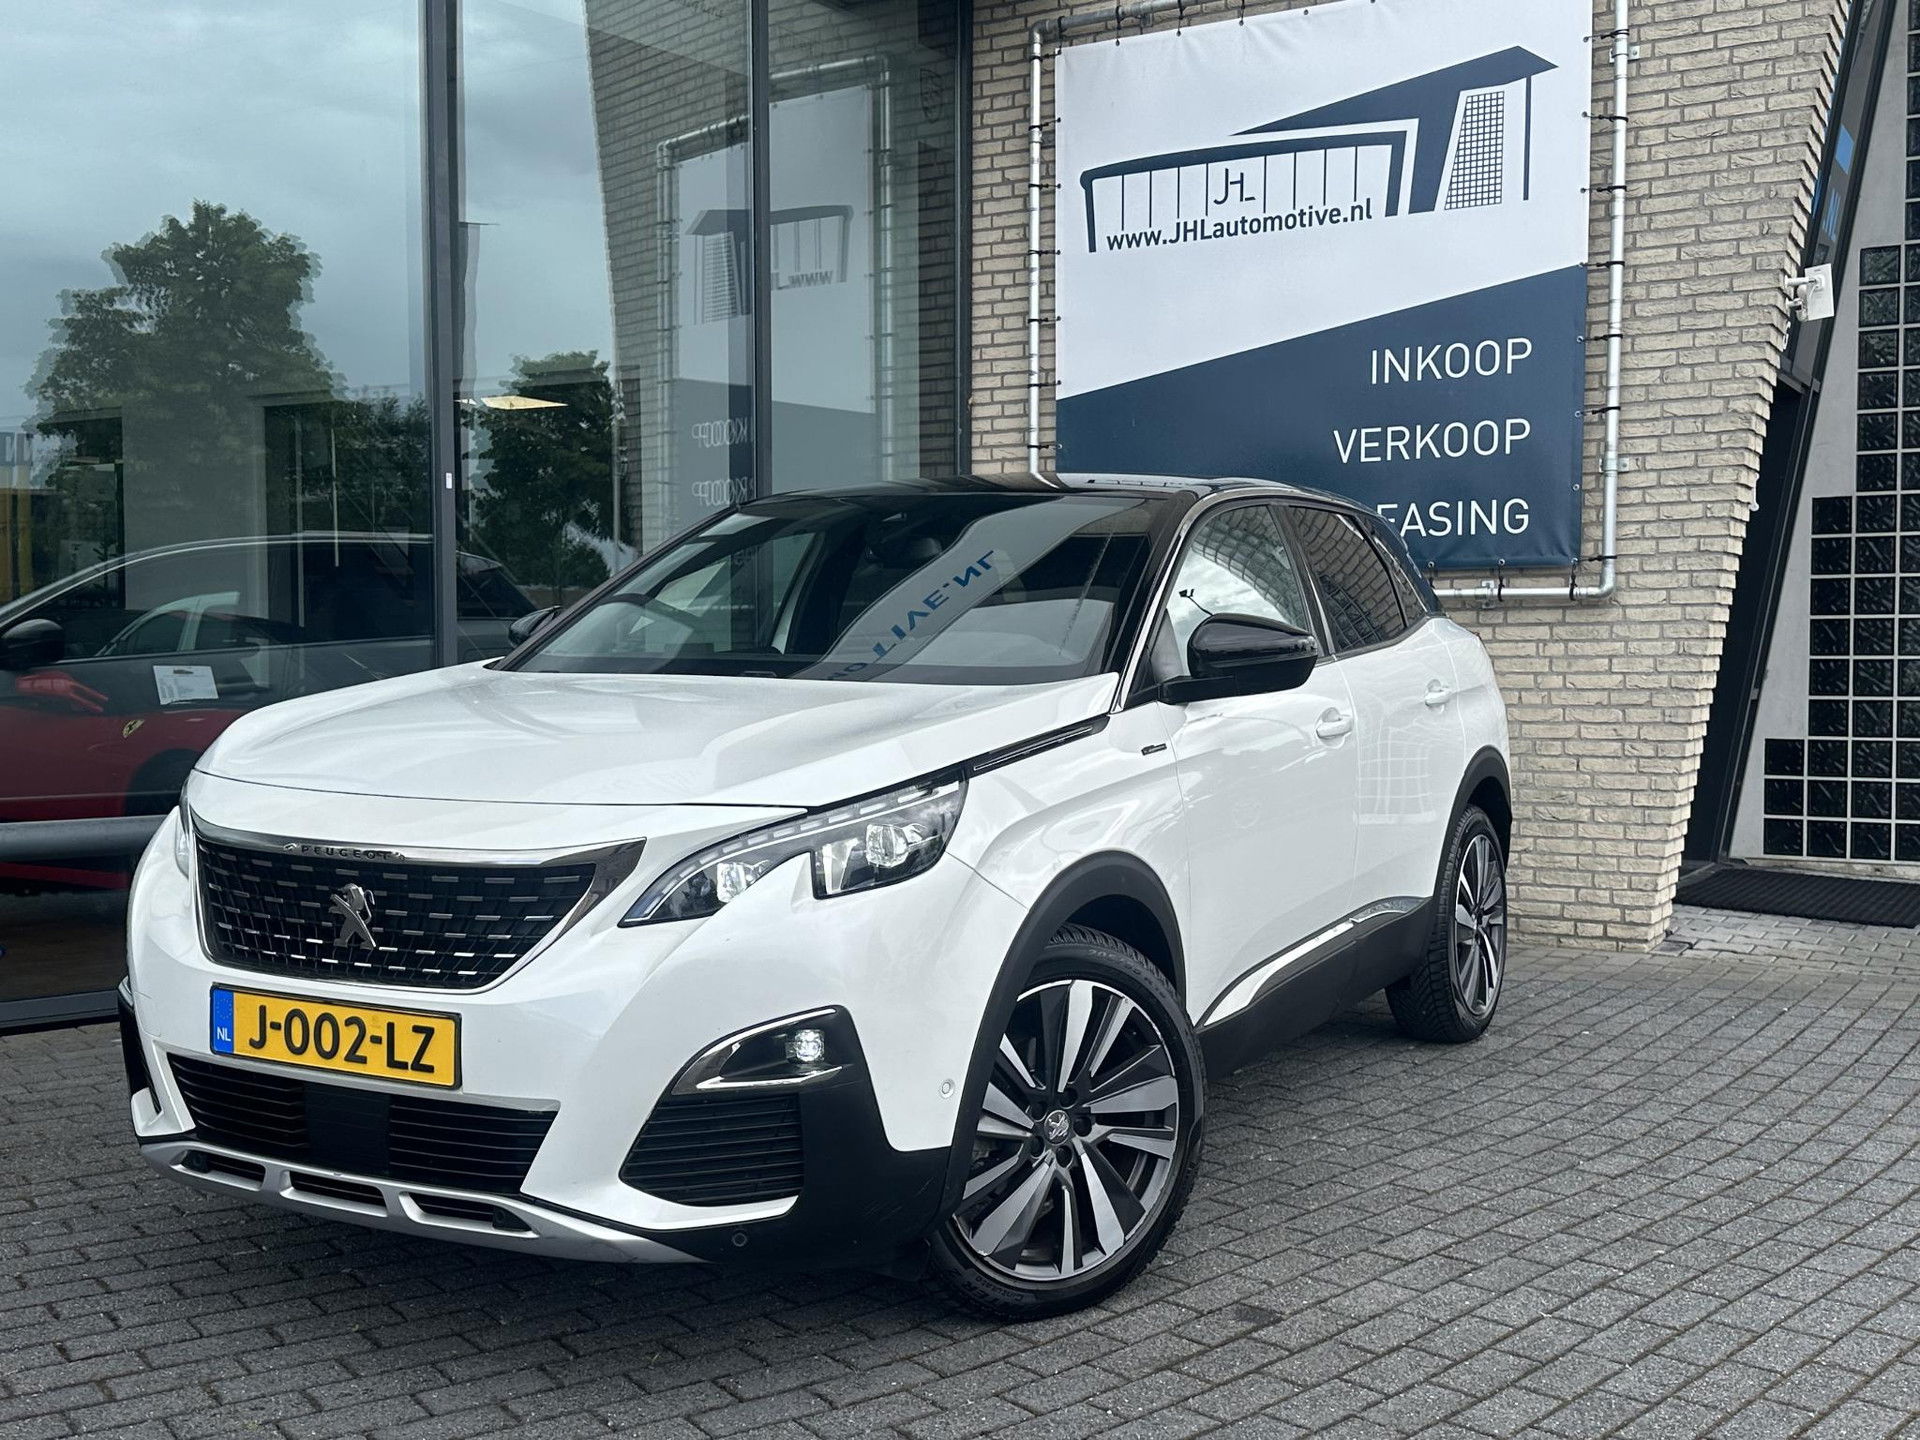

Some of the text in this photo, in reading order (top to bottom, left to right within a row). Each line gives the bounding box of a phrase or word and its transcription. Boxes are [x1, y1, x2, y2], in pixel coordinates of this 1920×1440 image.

[1213, 168, 1256, 205] JHL
[1106, 197, 1372, 250] www.JHLautomotive.nl
[1371, 337, 1533, 385] INKOOP
[1333, 418, 1531, 464] VERKOOP
[1376, 498, 1529, 537] ASING
[301, 844, 393, 860] PEUGEOT
[216, 1026, 232, 1042] NL
[249, 1004, 435, 1074] J-002-LZ
